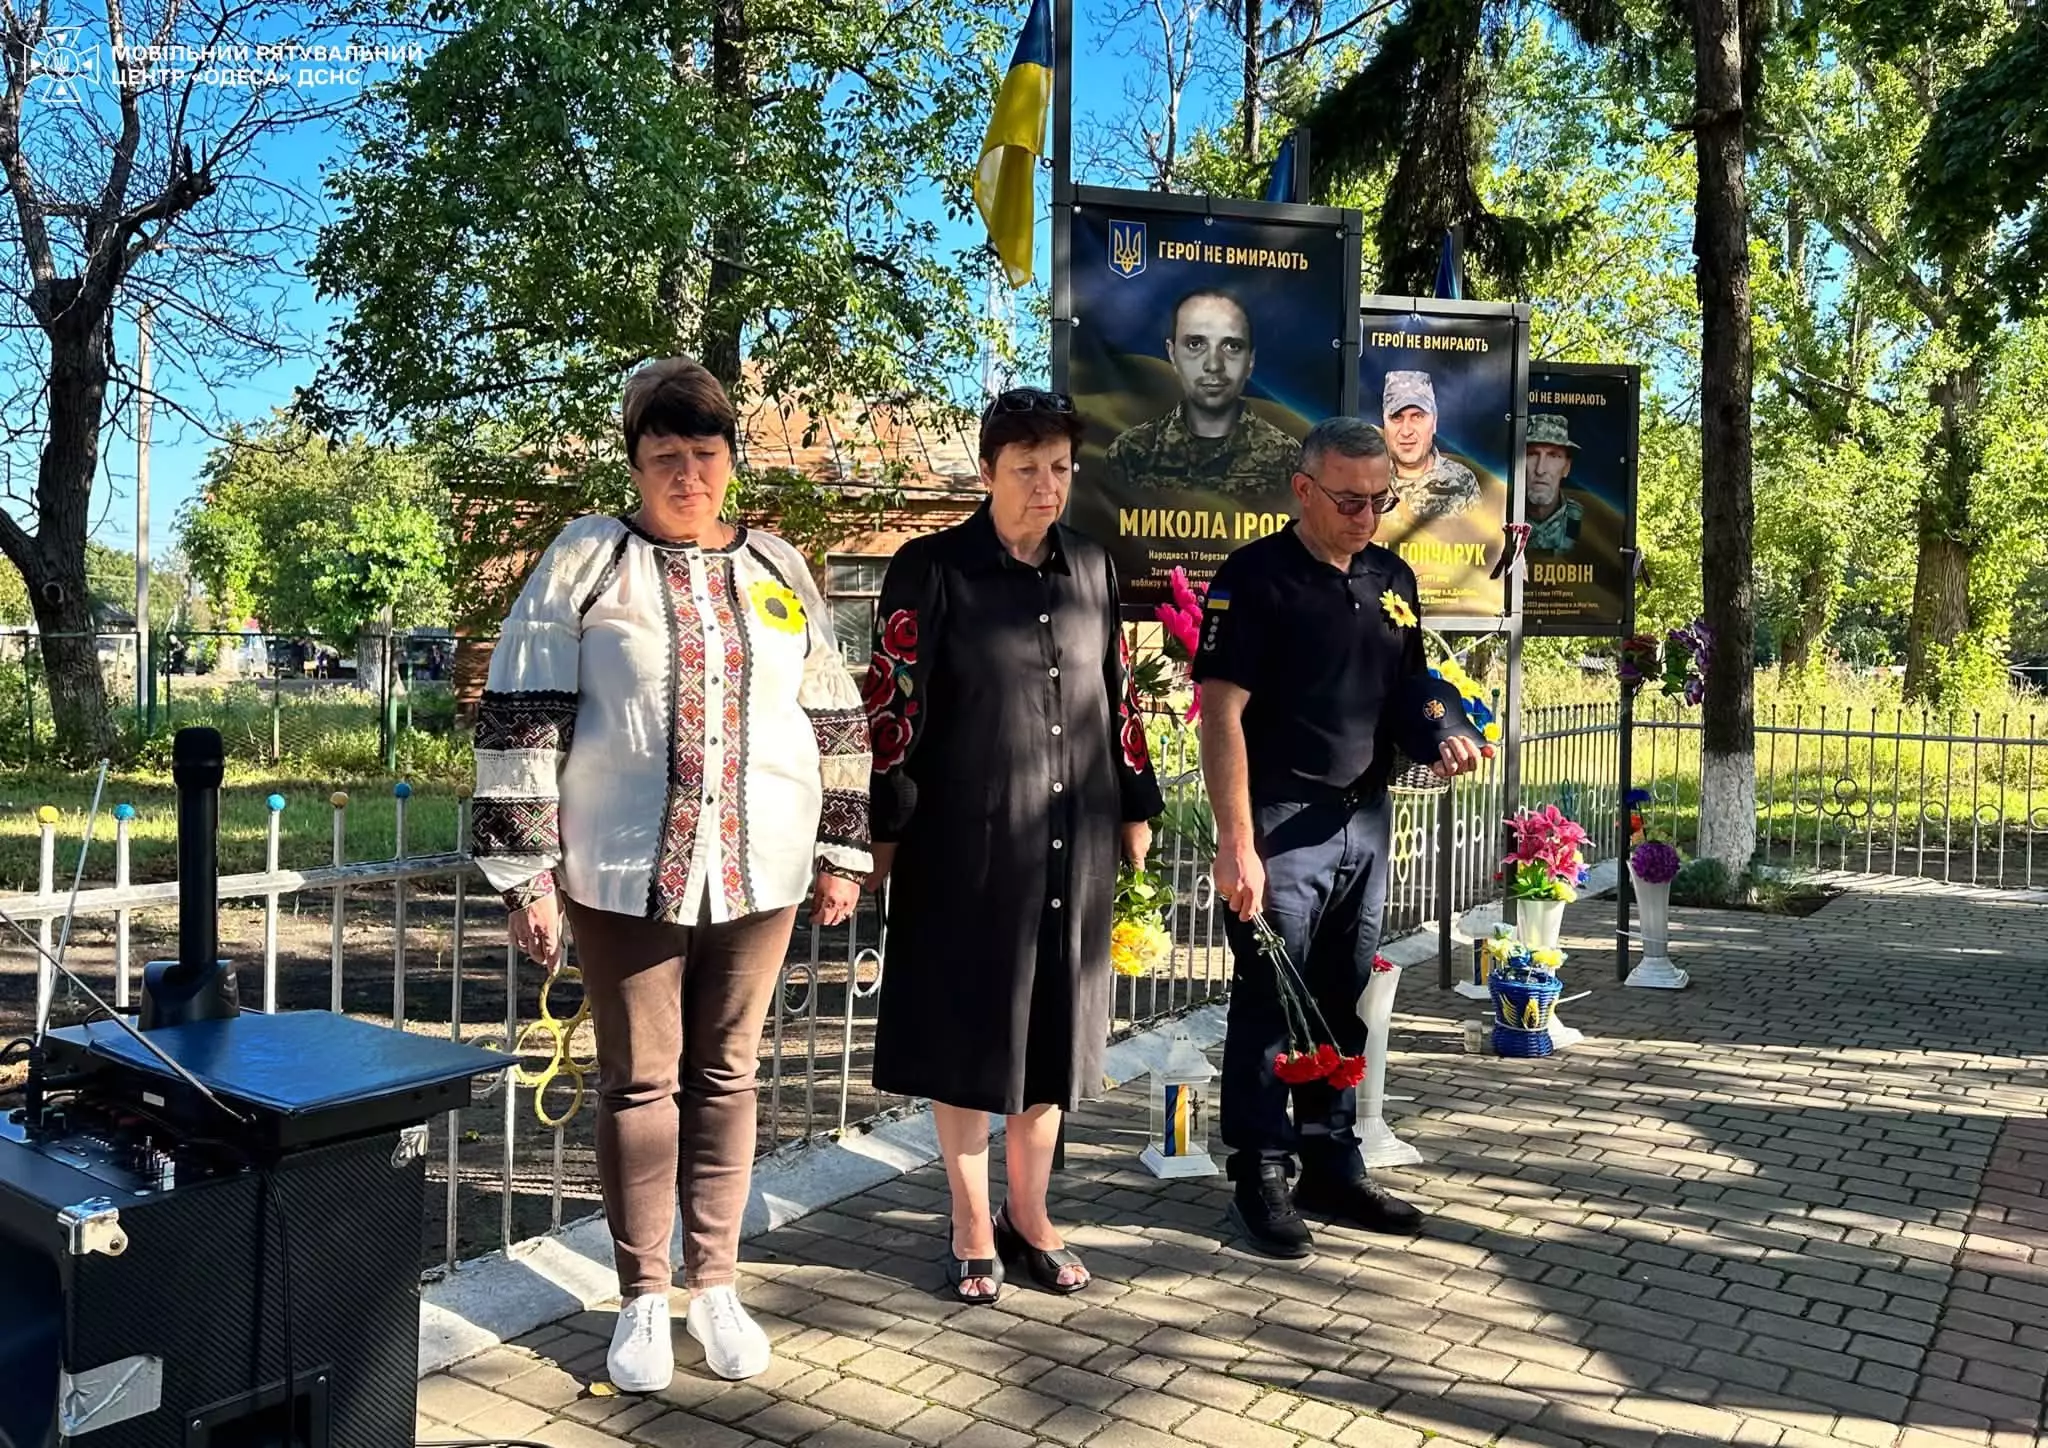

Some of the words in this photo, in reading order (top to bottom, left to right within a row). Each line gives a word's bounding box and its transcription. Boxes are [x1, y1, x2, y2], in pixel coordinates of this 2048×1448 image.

[1158, 240, 1202, 262] ГЕРОЇ
[1204, 244, 1223, 263] НЕ
[1226, 246, 1309, 271] ВМИРАЮТЬ
[1371, 330, 1406, 348] ГЕРОЇ
[1406, 333, 1421, 349] НЕ
[1423, 335, 1489, 352] ВМИРАЮТЬ
[1540, 391, 1553, 404] НЕ
[1554, 392, 1607, 406] ВМИРАЮТЬ
[1119, 508, 1228, 540] МИКОЛА
[1190, 551, 1199, 560] 17
[1533, 563, 1594, 586] ВДОВІН
